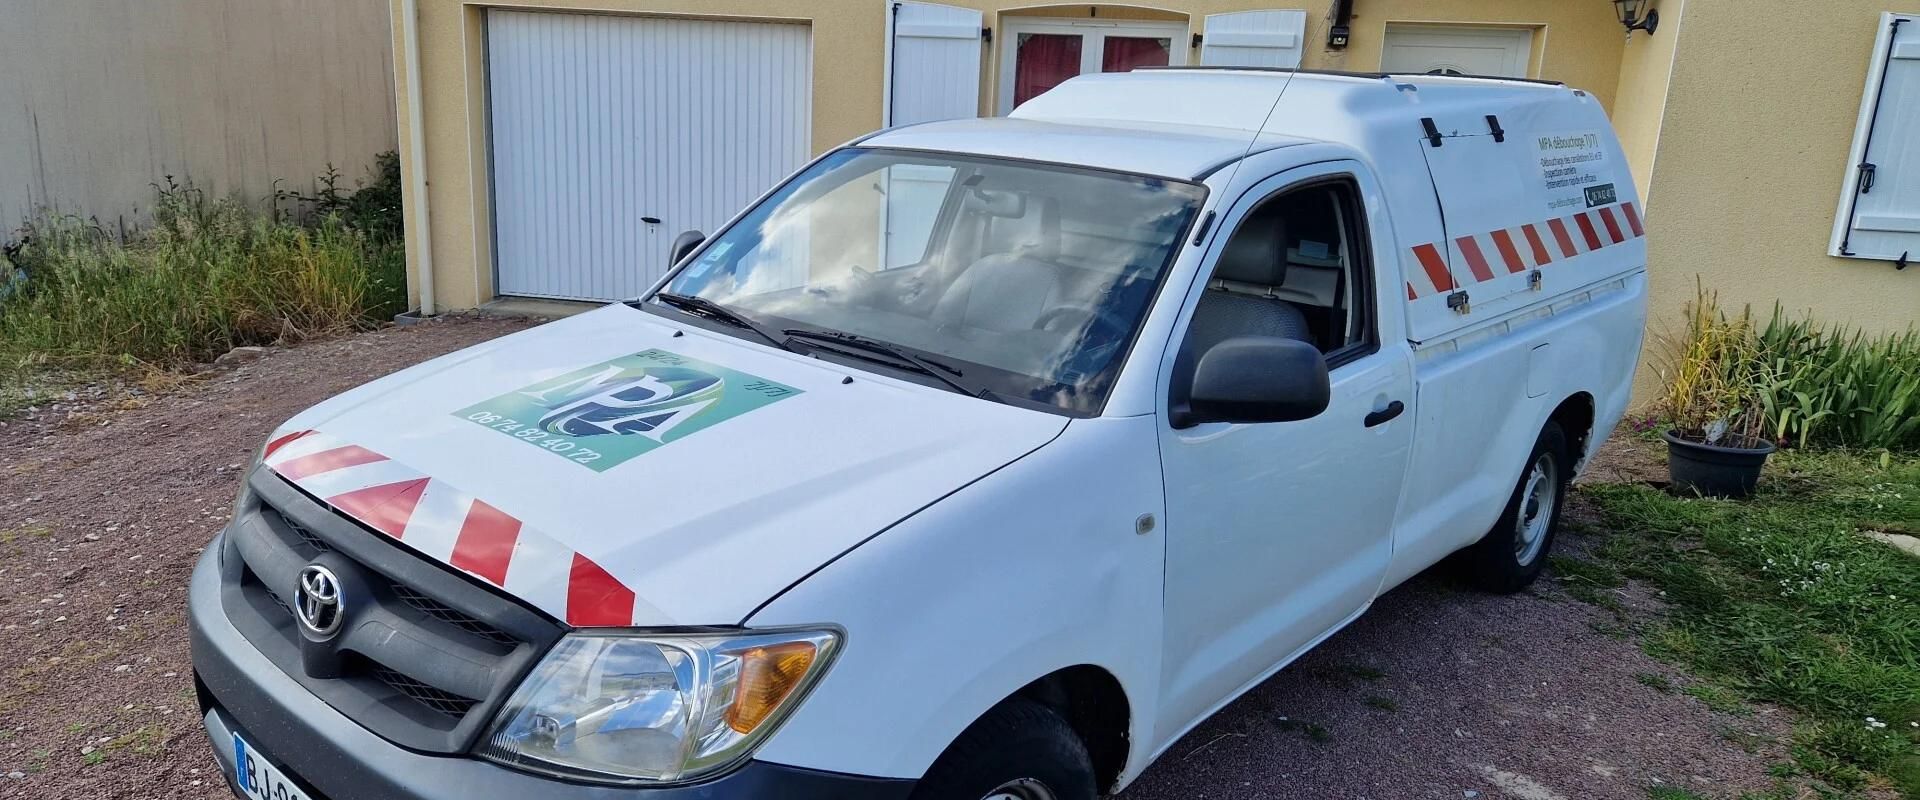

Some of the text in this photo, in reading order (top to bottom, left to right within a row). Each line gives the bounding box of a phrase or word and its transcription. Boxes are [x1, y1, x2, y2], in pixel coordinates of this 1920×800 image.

[1538, 136, 1553, 151] MPA
[519, 364, 718, 444] MPA
[468, 411, 603, 464] 06 74 82 40 72
